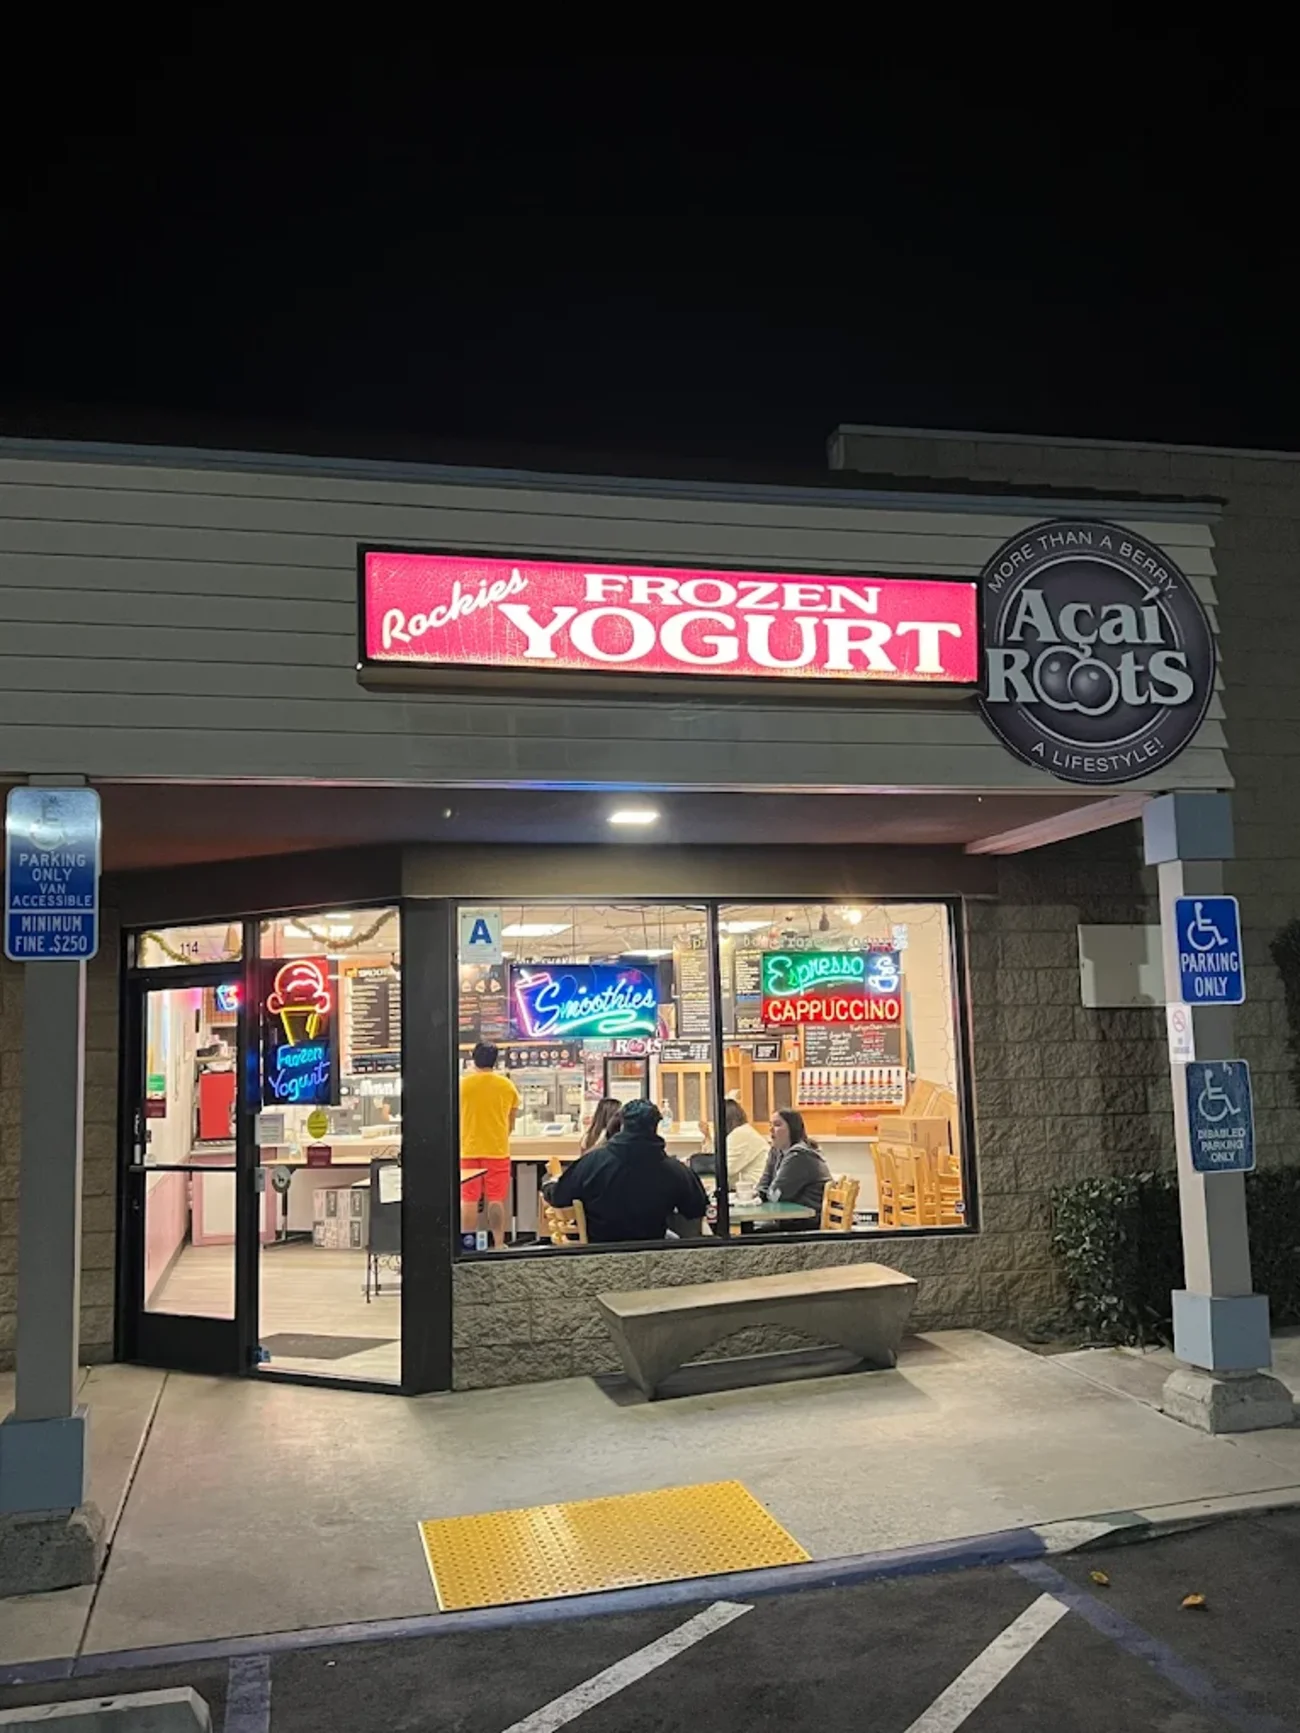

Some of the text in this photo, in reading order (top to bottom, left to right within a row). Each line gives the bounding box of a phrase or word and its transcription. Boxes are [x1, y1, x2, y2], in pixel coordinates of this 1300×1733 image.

[988, 544, 1034, 593] MORE
[1038, 531, 1092, 550] THAN
[1100, 535, 1113, 549] A
[584, 573, 881, 614] FROZEN
[382, 567, 528, 649] Rockies
[499, 604, 961, 675] YOGURT
[1032, 737, 1165, 772] A LIFESTYLE!
[19, 853, 86, 867] PARKING
[32, 868, 72, 882] ONLY
[40, 883, 66, 895] VAN
[12, 895, 92, 907] ACCESSIBLE
[22, 915, 82, 932] MINIMUM
[469, 918, 492, 944] A
[15, 935, 45, 952] FINE
[180, 941, 199, 954] 114
[1181, 952, 1239, 973] PARKING
[767, 956, 864, 995] Espresso
[1194, 976, 1228, 997] ONLY
[535, 978, 656, 1034] Smoothies
[768, 999, 899, 1021] CAPPUCCINO
[276, 1044, 322, 1070] Frozen
[268, 1061, 330, 1101] Yogurt
[1197, 1128, 1246, 1140] DISABLED
[1201, 1139, 1245, 1151] PARKING
[1210, 1151, 1236, 1163] ONLY
